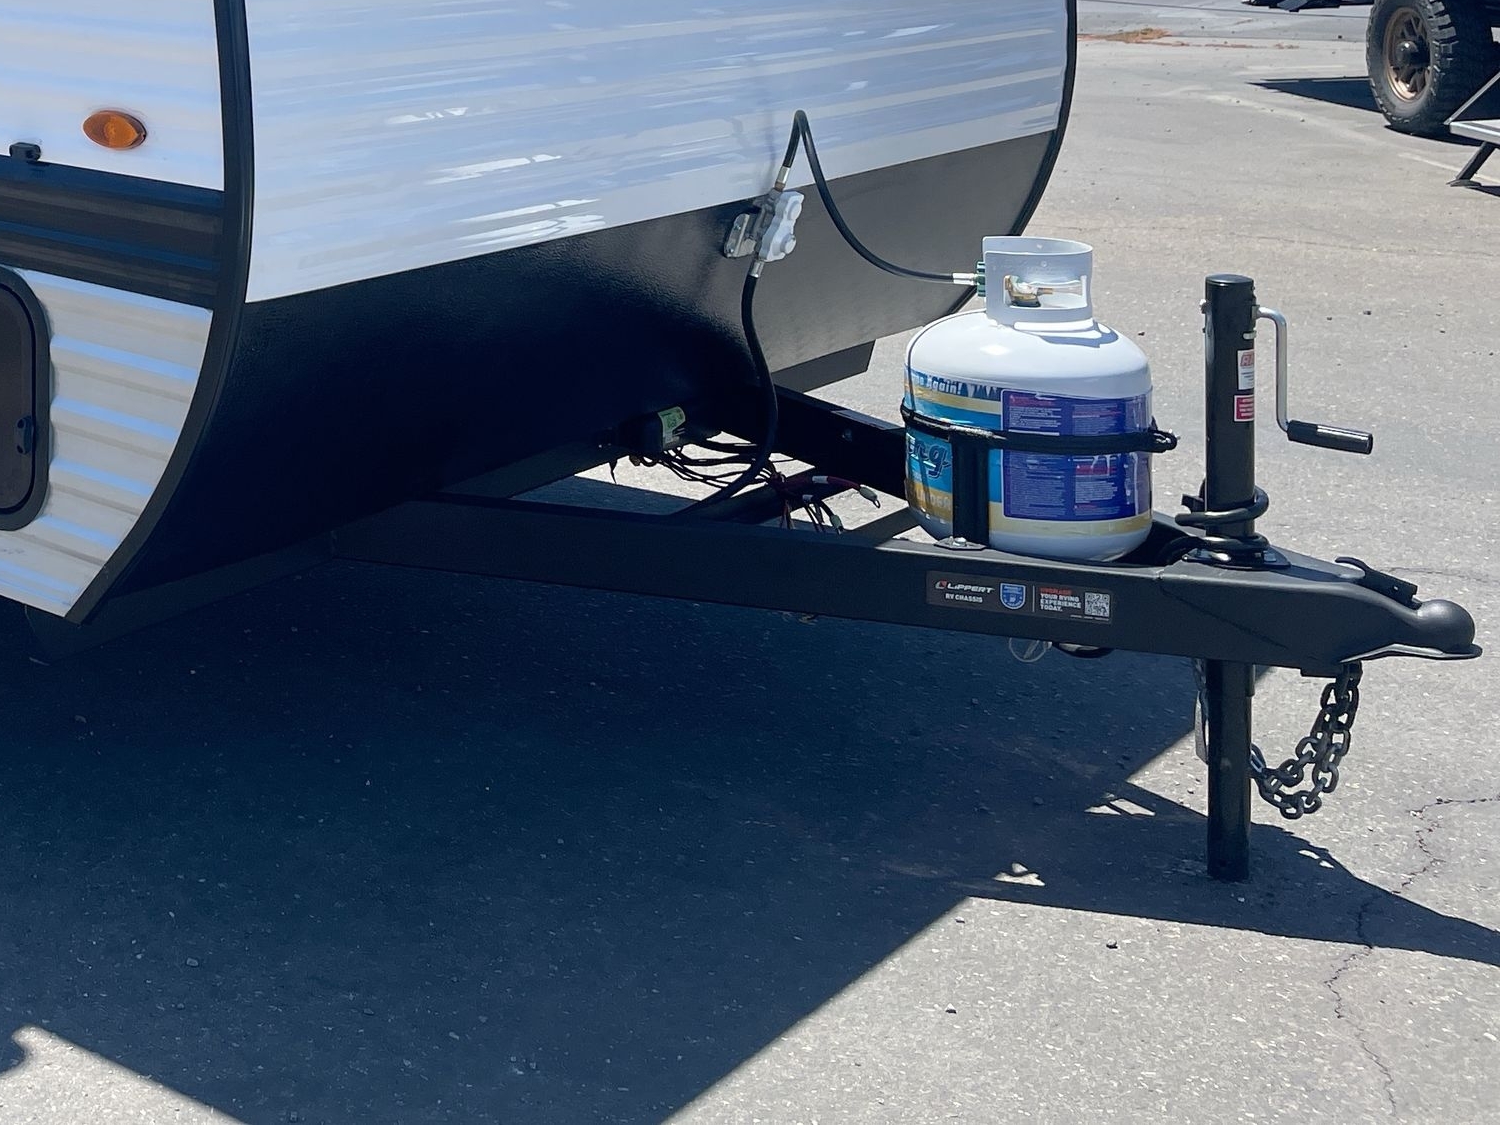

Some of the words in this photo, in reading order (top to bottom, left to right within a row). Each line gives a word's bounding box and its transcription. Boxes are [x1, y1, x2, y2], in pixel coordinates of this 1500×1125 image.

[947, 582, 996, 594] LIPPERT
[945, 592, 955, 600] RV
[954, 594, 983, 604] CHASSIS
[1040, 592, 1059, 601] YOUR
[1058, 594, 1080, 603] RVING
[1040, 598, 1082, 609] EXPERIENCE
[1040, 604, 1063, 612] TODAY.
